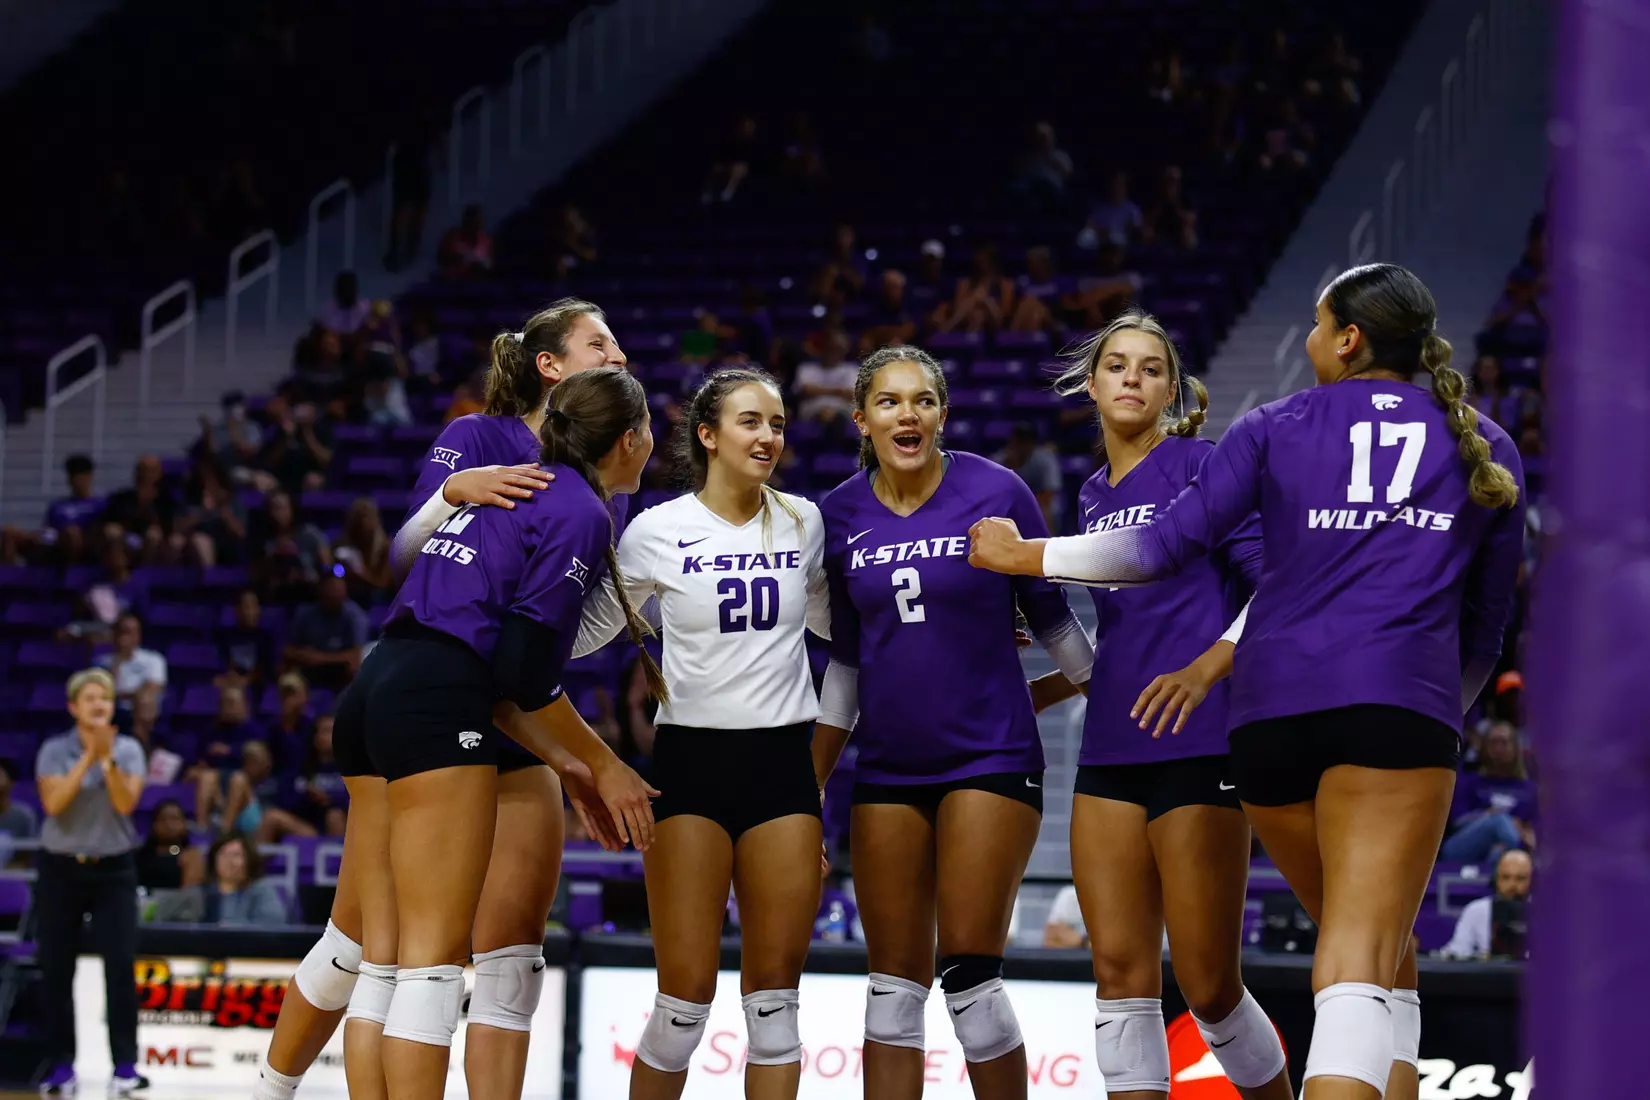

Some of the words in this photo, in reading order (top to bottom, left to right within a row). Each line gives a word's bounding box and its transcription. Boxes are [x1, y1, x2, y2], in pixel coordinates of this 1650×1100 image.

[1347, 421, 1426, 504] 17
[1308, 505, 1455, 531] WILDATS
[421, 538, 477, 565] DCATS
[682, 550, 800, 574] K-STATE
[852, 536, 966, 570] K-STATE
[717, 576, 779, 633] 20
[891, 566, 926, 623] 2
[133, 960, 294, 1028] Brigg
[146, 1047, 214, 1068] MC
